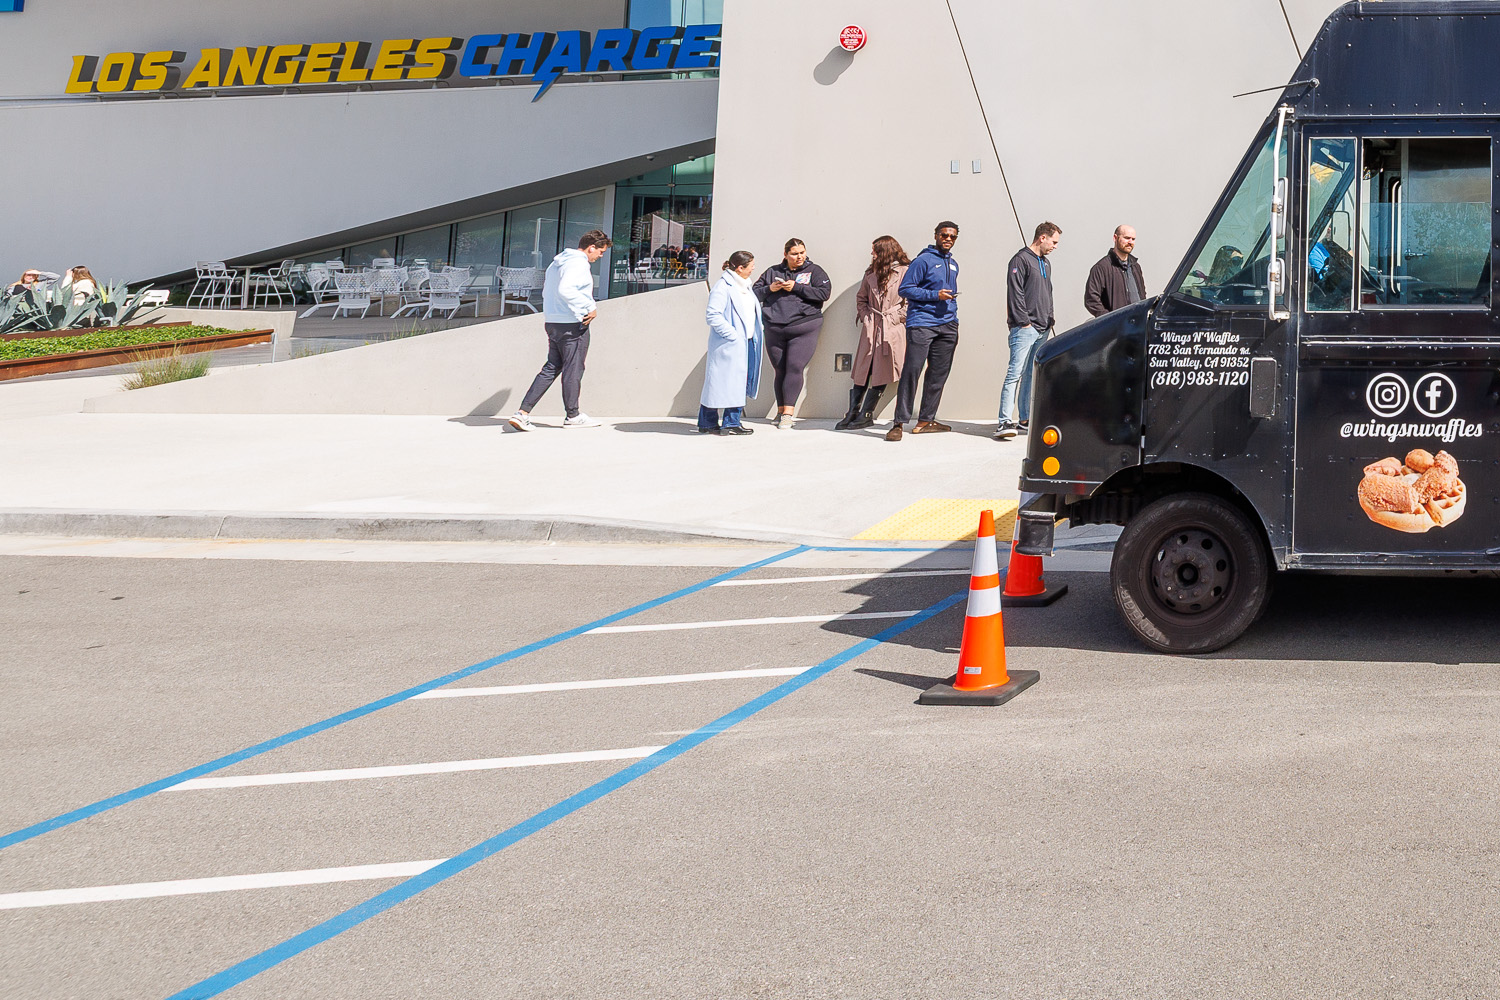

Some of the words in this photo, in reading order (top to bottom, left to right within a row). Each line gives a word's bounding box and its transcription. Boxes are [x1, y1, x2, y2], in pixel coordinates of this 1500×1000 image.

[65, 50, 175, 94] LOS
[183, 36, 453, 89] ANGELES
[459, 23, 721, 103] CHARGE
[1160, 332, 1192, 345] Wings
[1204, 332, 1240, 345] Waffles
[1148, 344, 1171, 355] 7782
[1173, 344, 1192, 355] San
[1193, 344, 1238, 355] Fernando
[1149, 356, 1168, 368] Sun
[1169, 356, 1202, 370] Valley,
[1204, 356, 1218, 368] CA
[1220, 356, 1249, 368] 91352
[1340, 418, 1483, 443] @wingsnwaffles
